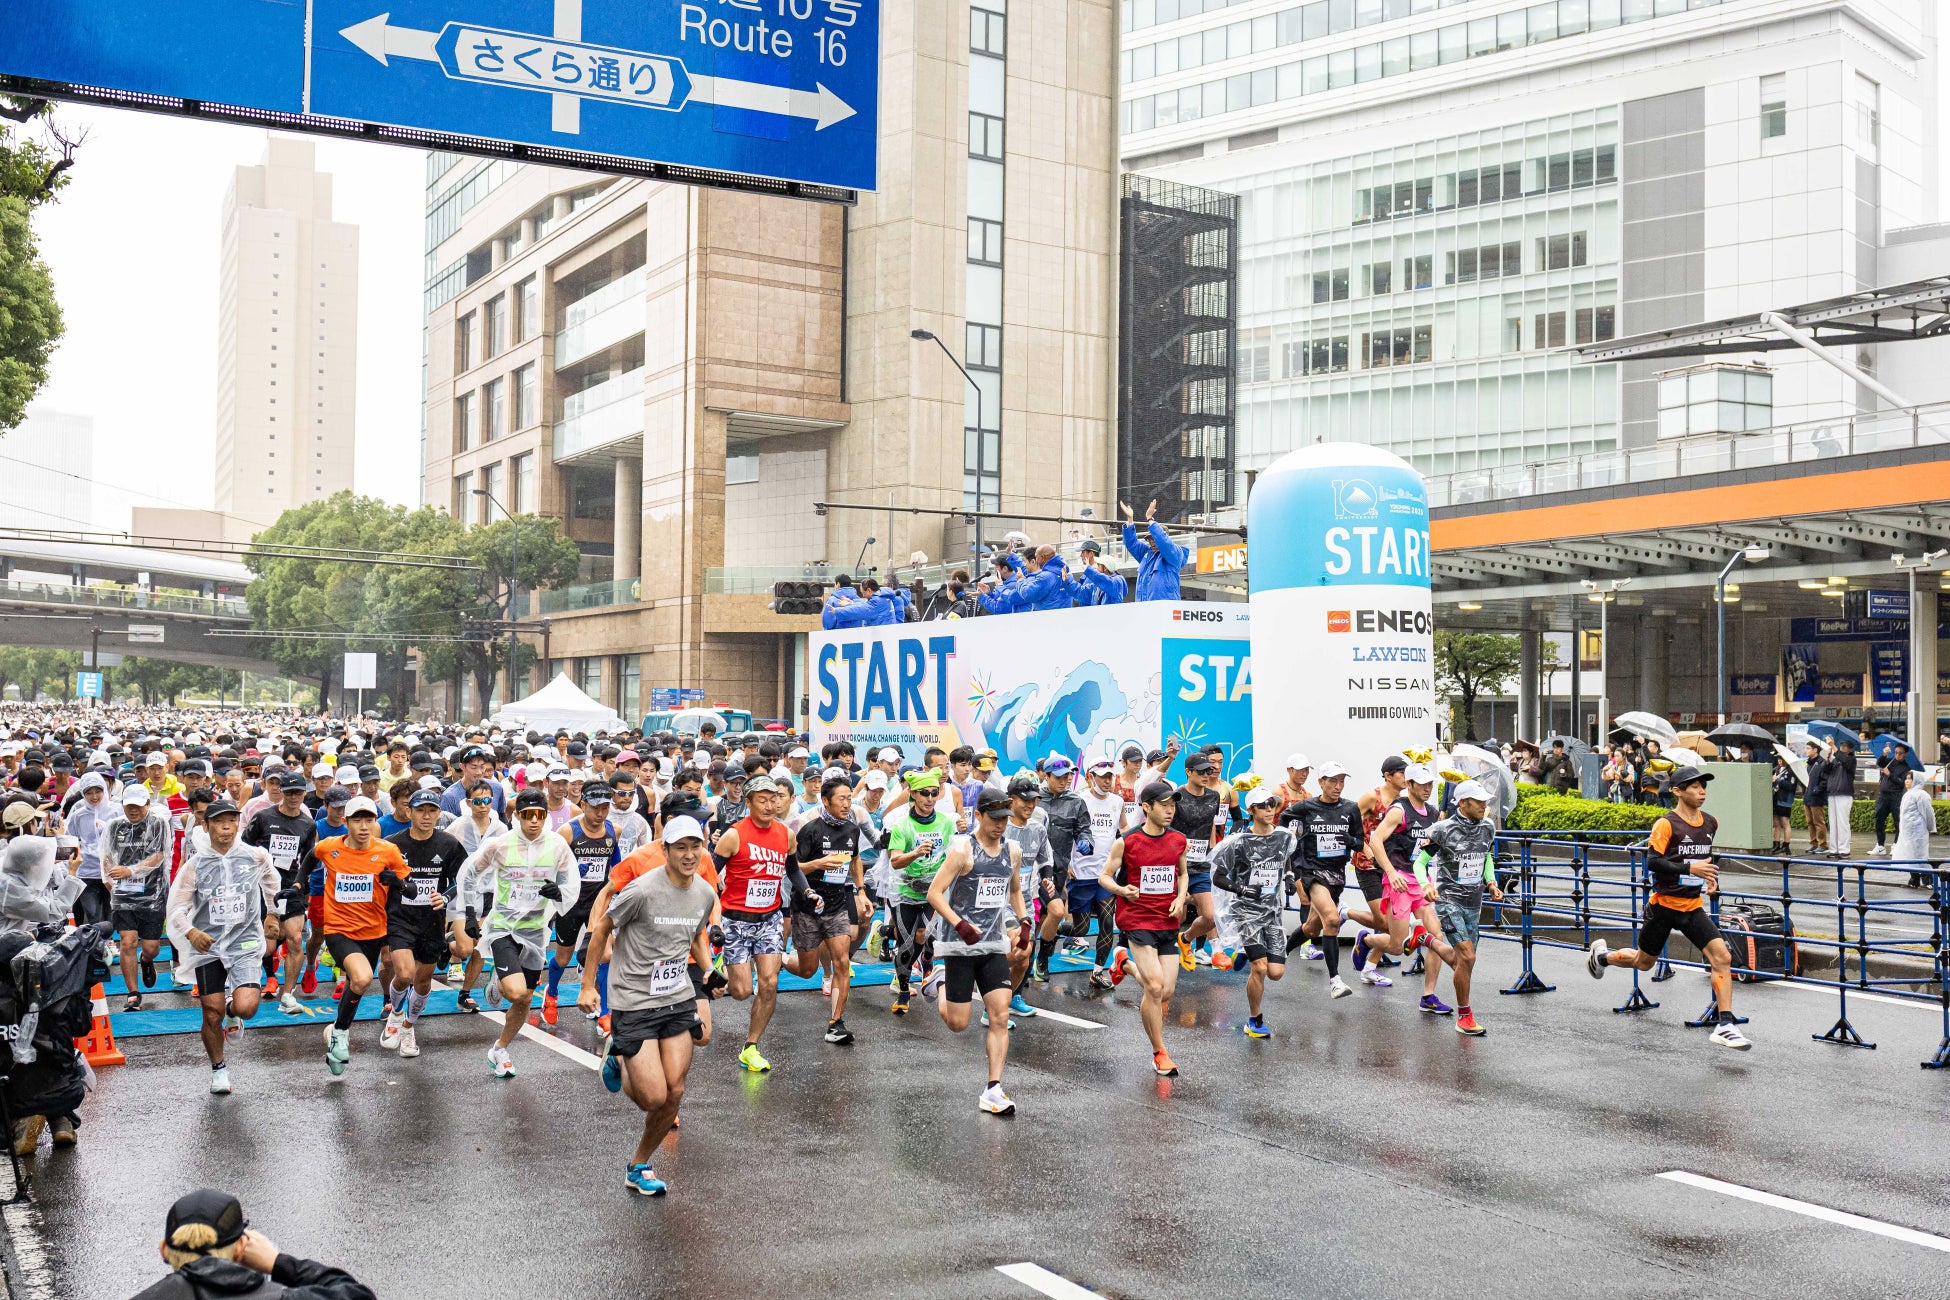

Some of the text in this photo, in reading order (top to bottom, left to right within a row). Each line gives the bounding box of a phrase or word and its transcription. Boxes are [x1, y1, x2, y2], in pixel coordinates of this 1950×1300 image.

[681, 4, 792, 58] Route
[813, 27, 847, 67] 16
[473, 38, 656, 95] さくら通り
[1325, 526, 1430, 577] START
[1183, 610, 1223, 622] ENEOS
[1356, 610, 1431, 635] ENEOS
[1820, 621, 1849, 632] KeePer
[1352, 646, 1426, 662] LAWSON
[82, 678, 97, 693] E
[818, 636, 955, 725] START
[1348, 678, 1430, 690] NISSAN
[1738, 679, 1769, 690] KeePer
[1822, 678, 1856, 690] KeePer
[1348, 706, 1388, 719] PUMA
[828, 734, 838, 742] RUN
[901, 735, 916, 743] YOUR
[918, 735, 940, 744] WORLD.
[1096, 819, 1112, 827] 6515
[278, 842, 297, 850] 5226
[747, 842, 779, 862] RUN
[1678, 845, 1695, 854] PACE
[1142, 874, 1172, 884] A 5040
[748, 888, 775, 897] A 5893
[979, 886, 1005, 896] A 5055
[211, 902, 245, 914] A 568
[653, 970, 660, 980] A
